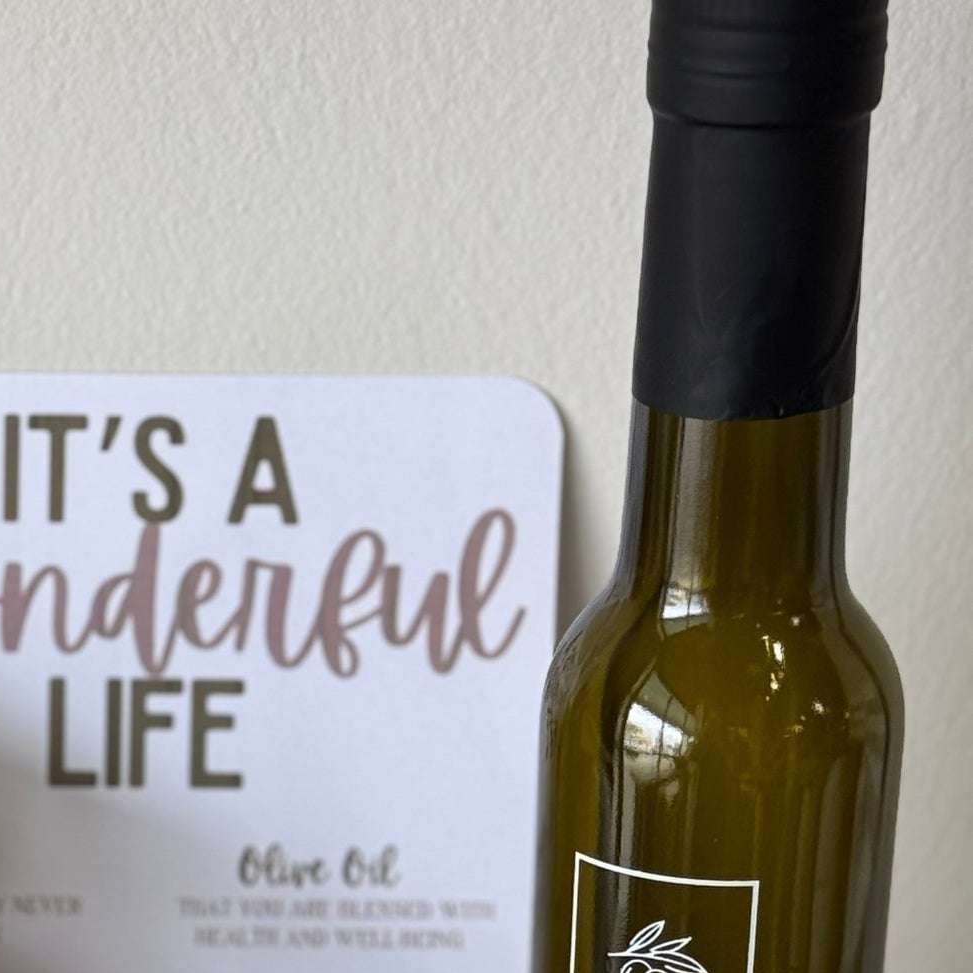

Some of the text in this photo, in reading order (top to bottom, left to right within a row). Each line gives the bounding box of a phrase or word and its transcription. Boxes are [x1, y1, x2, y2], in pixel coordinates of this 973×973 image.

[3, 414, 299, 526] IT'S A
[47, 677, 245, 789] LIFE
[237, 842, 402, 889] Olive Oil
